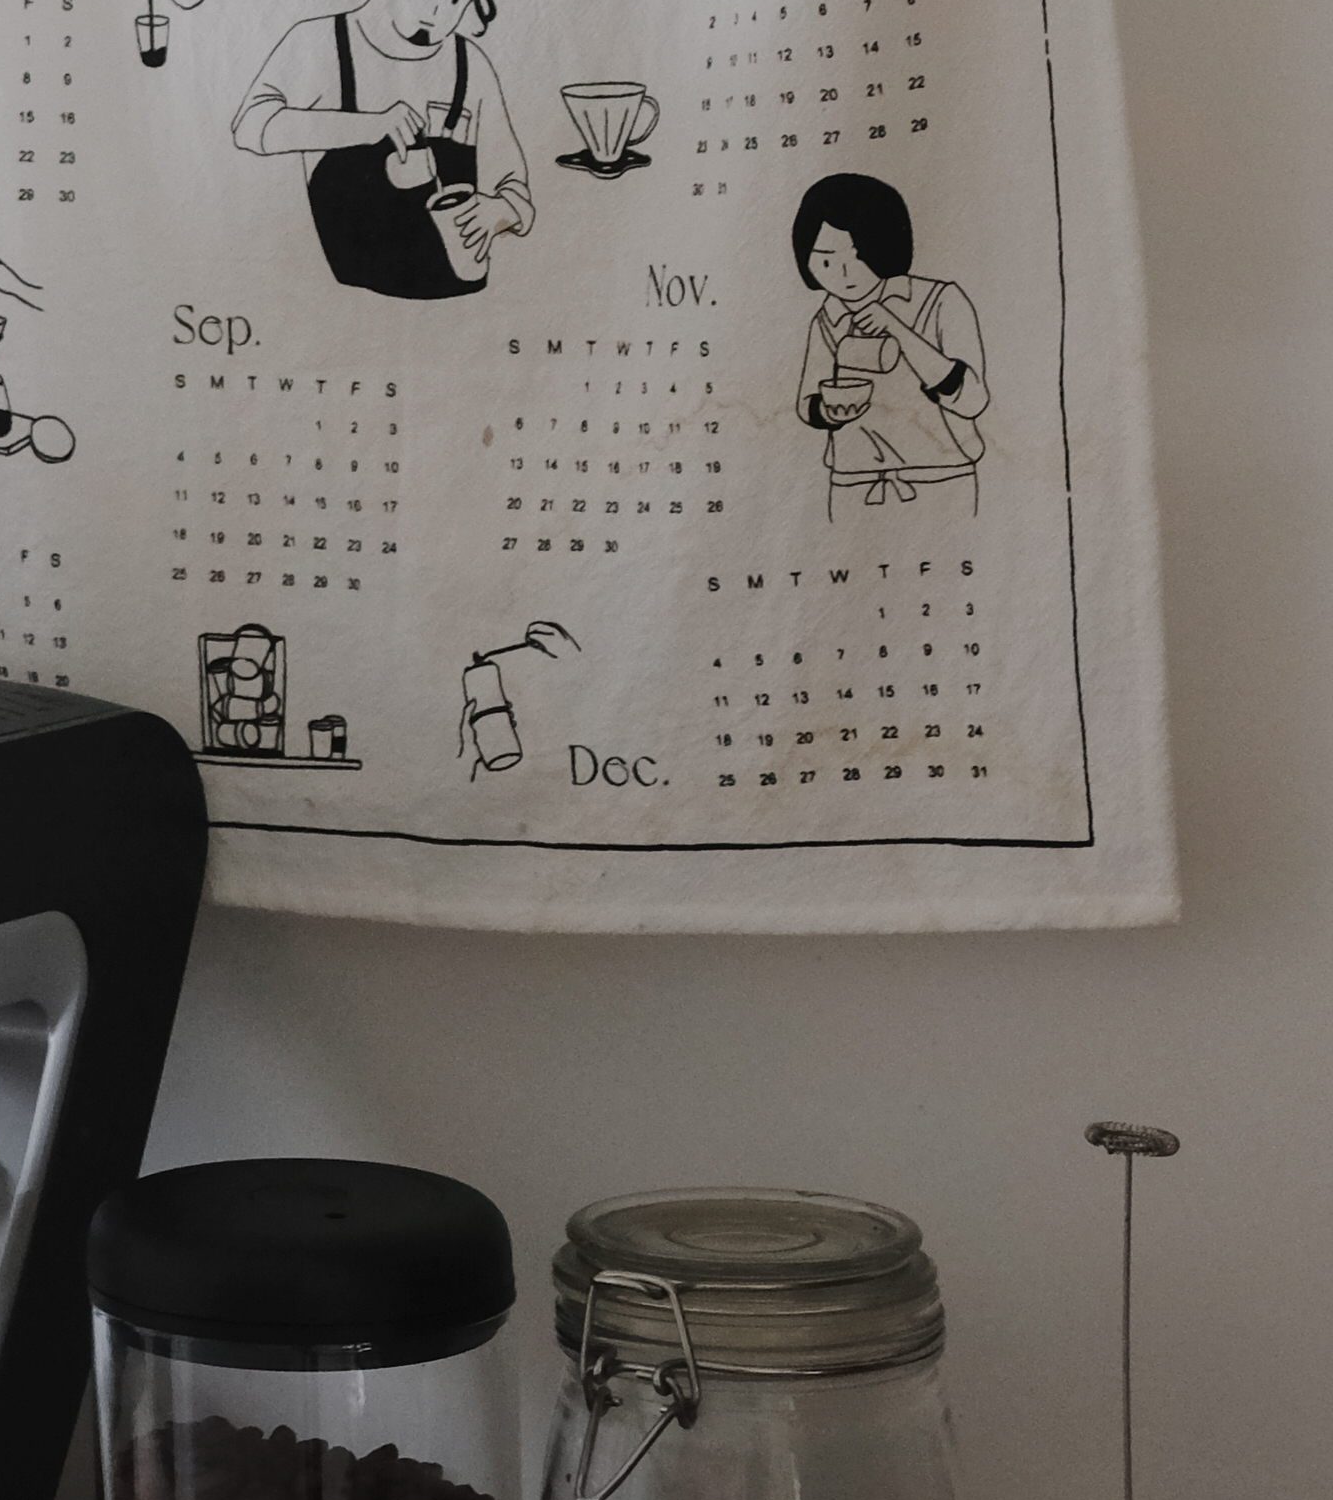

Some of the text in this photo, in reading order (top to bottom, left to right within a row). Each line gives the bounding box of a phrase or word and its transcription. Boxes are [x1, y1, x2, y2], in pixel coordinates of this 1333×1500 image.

[779, 75, 925, 104] 19 20 21 22
[19, 150, 35, 163] 22
[59, 151, 75, 165] 23
[646, 264, 717, 307] Nov.
[173, 304, 260, 355] Sep.
[175, 374, 397, 398] S M T W T F S
[506, 497, 723, 514] 20 21 22 23 24 25 26
[173, 528, 397, 554] 18 19 20 21 22 23 24
[707, 560, 974, 592] S M T W T F S
[713, 683, 981, 707] 11 12 13 14 15 16 17
[568, 745, 669, 787] Dec.
